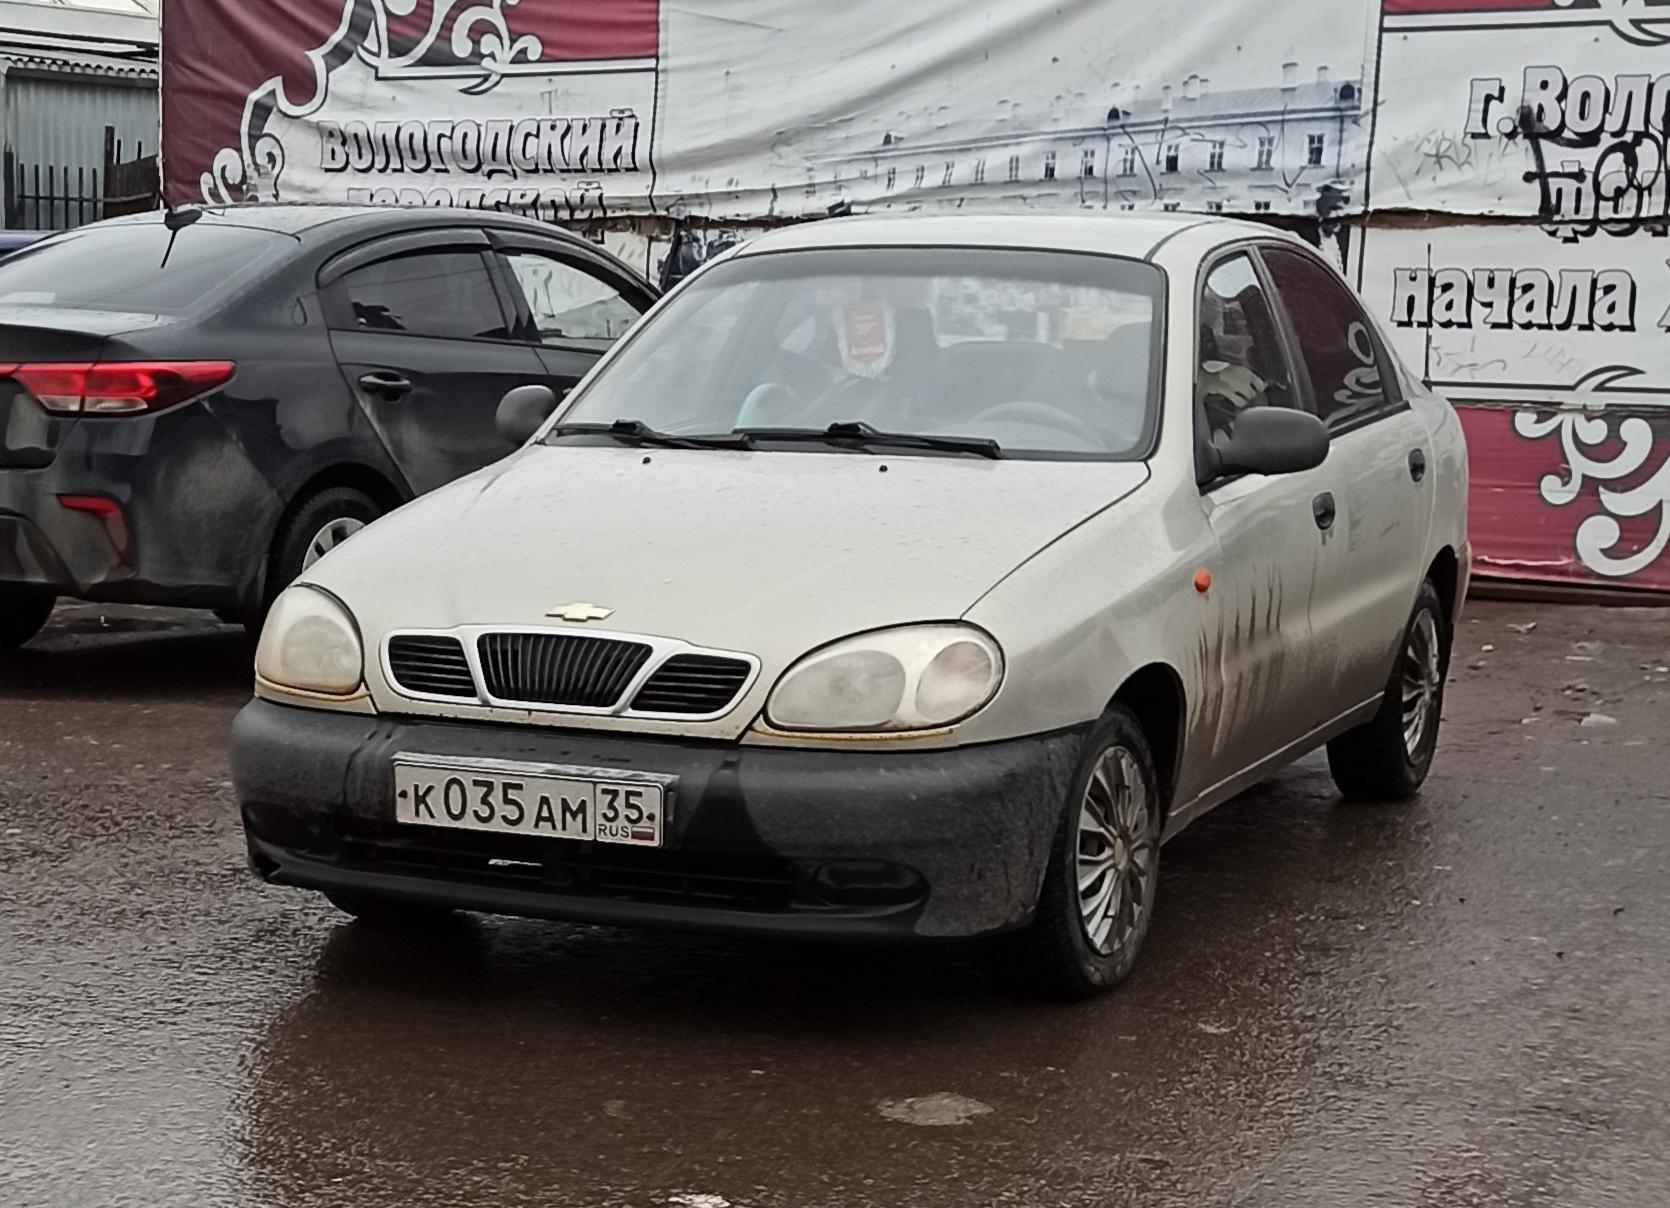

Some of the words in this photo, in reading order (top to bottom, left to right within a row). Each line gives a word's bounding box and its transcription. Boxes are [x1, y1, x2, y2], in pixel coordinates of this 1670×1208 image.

[1390, 267, 1636, 332] начала
[412, 776, 588, 834] К035АМ
[600, 787, 644, 825] 35
[598, 823, 630, 839] RUS
